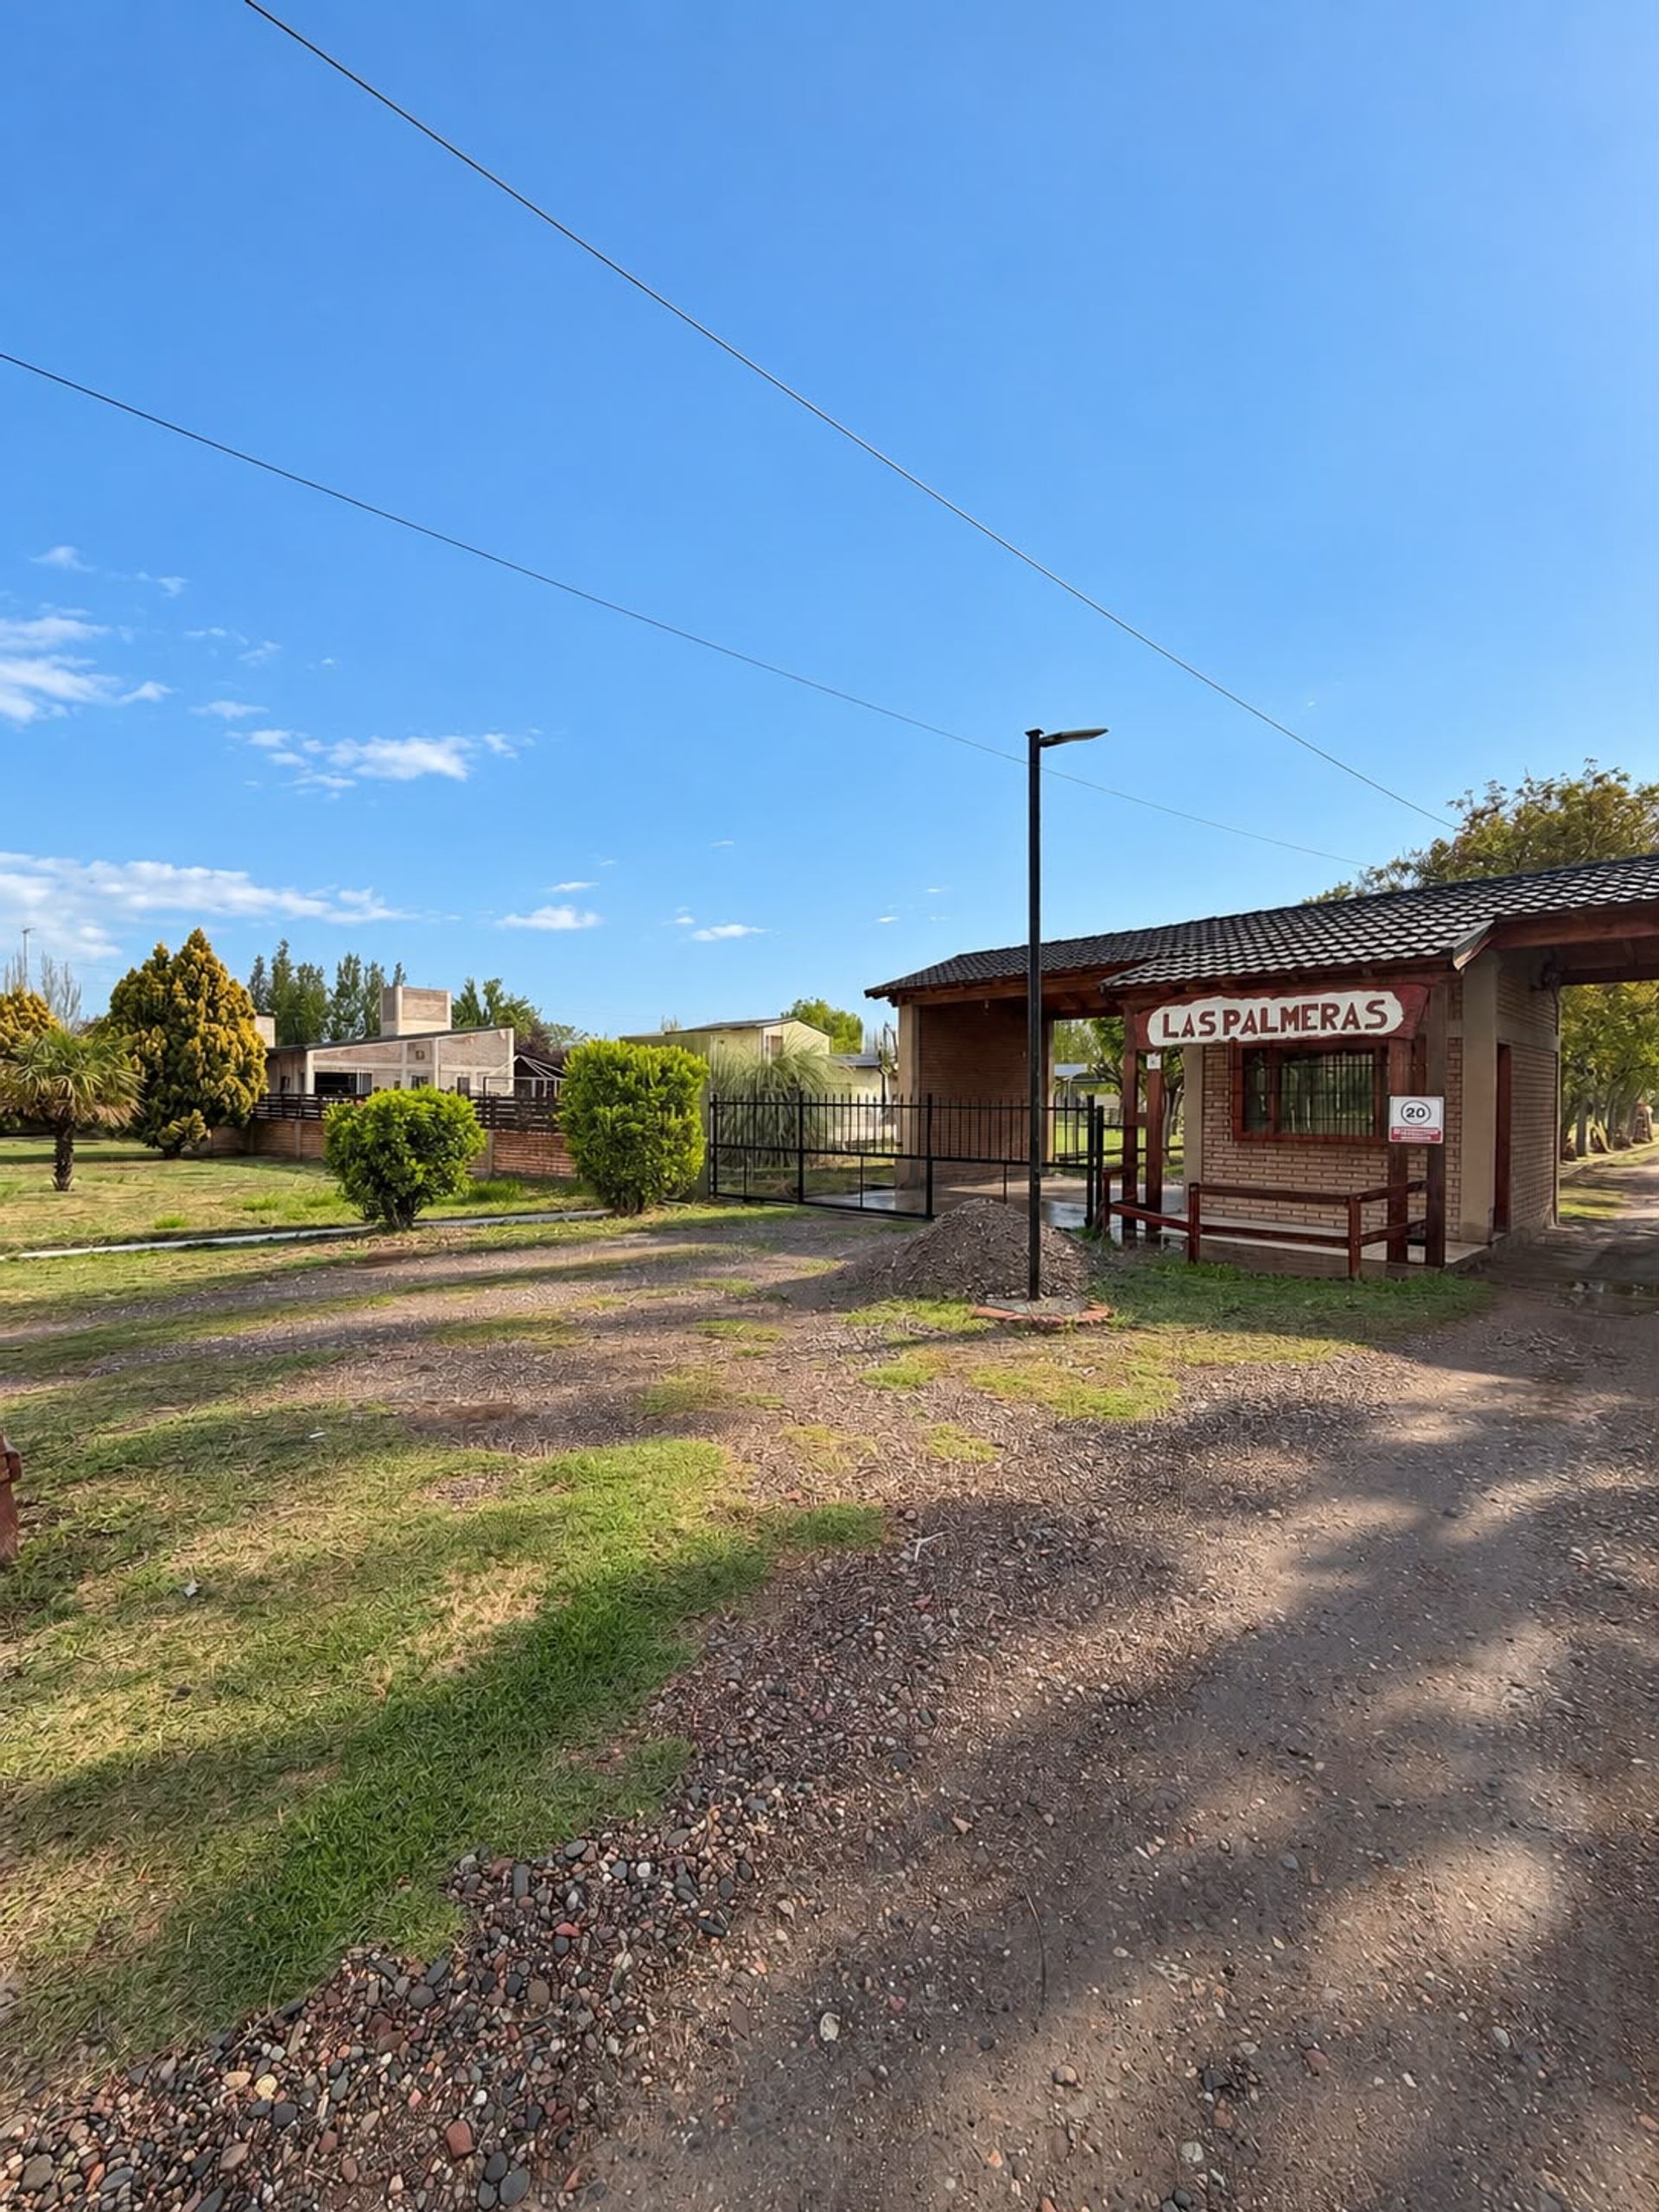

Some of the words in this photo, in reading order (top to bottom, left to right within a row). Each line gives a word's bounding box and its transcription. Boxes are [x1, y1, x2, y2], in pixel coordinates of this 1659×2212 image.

[1162, 1011, 1217, 1038] LAS
[1222, 999, 1388, 1036] PALMERAS
[1405, 1107, 1427, 1118] 20
